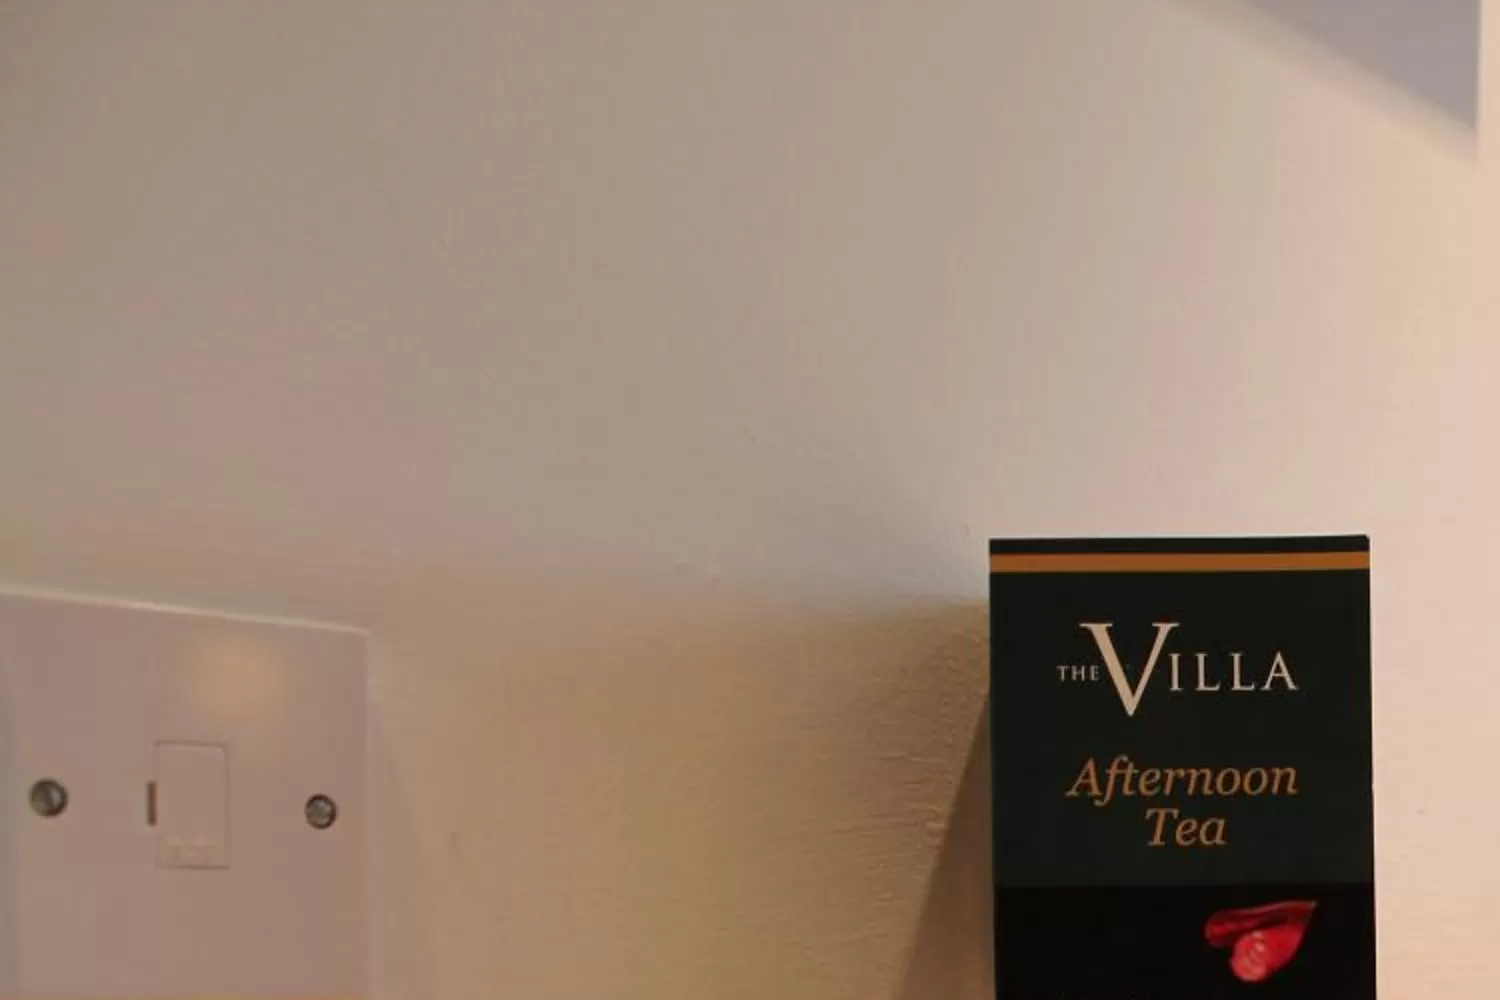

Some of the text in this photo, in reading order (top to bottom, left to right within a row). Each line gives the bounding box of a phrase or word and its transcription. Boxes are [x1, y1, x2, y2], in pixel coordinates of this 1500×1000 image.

[1056, 621, 1299, 718] THE VILLA
[1065, 754, 1298, 807] Afternoon
[1145, 806, 1226, 847] Tea
